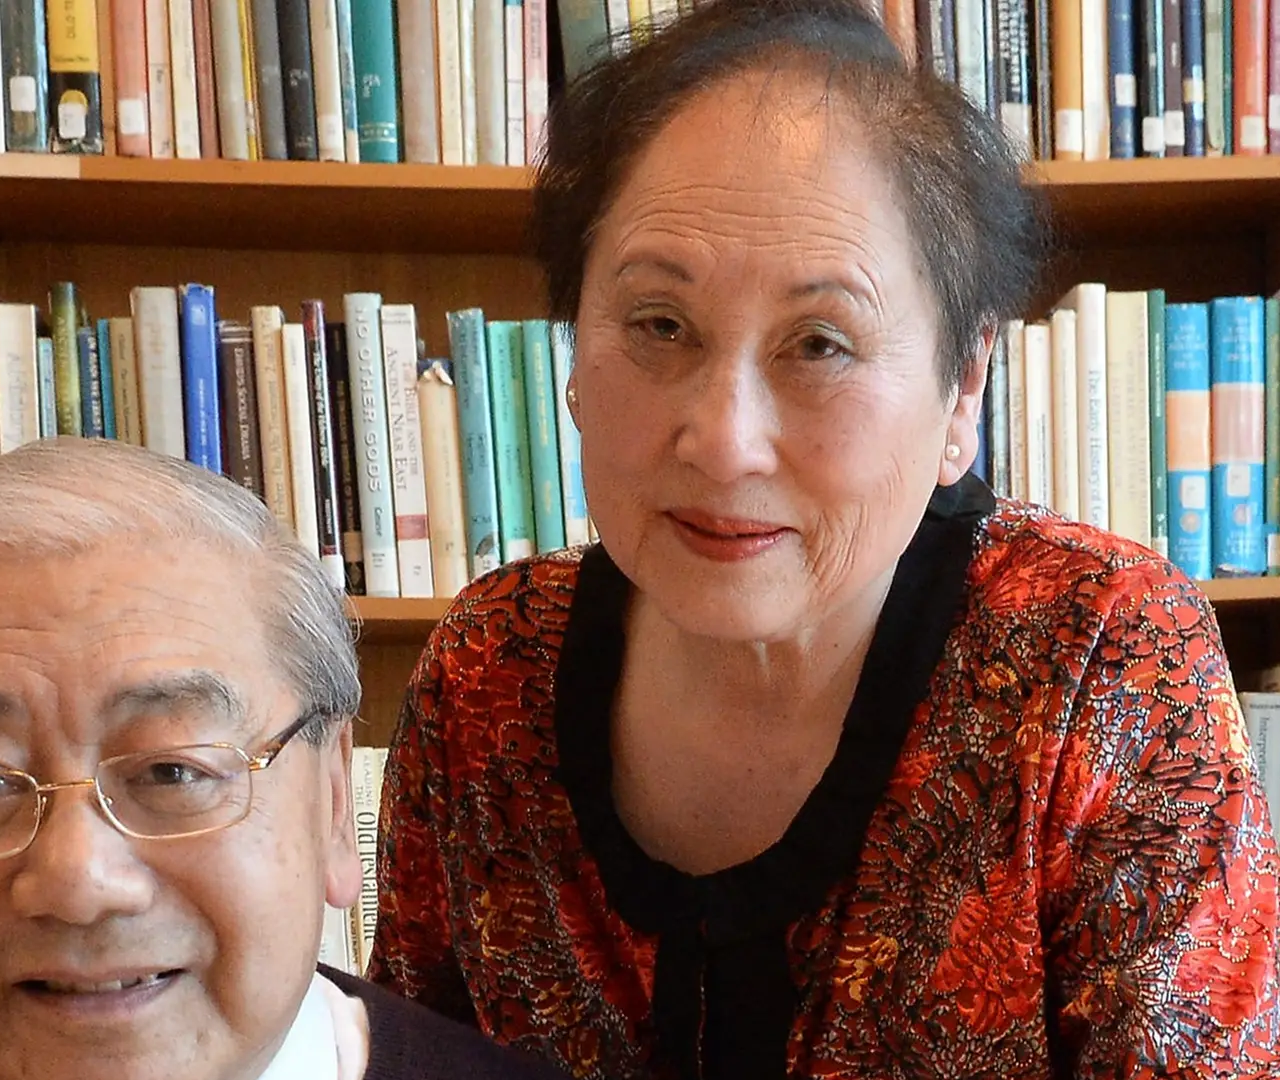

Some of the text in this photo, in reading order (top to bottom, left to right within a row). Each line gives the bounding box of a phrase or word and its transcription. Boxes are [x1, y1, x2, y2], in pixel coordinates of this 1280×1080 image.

[358, 349, 377, 427] OTHER
[404, 387, 417, 426] BIBLE
[385, 346, 408, 491] ANCIENT NEAR EAST
[365, 432, 382, 494] GODS
[1087, 430, 1102, 487] History
[356, 811, 379, 846] Old
